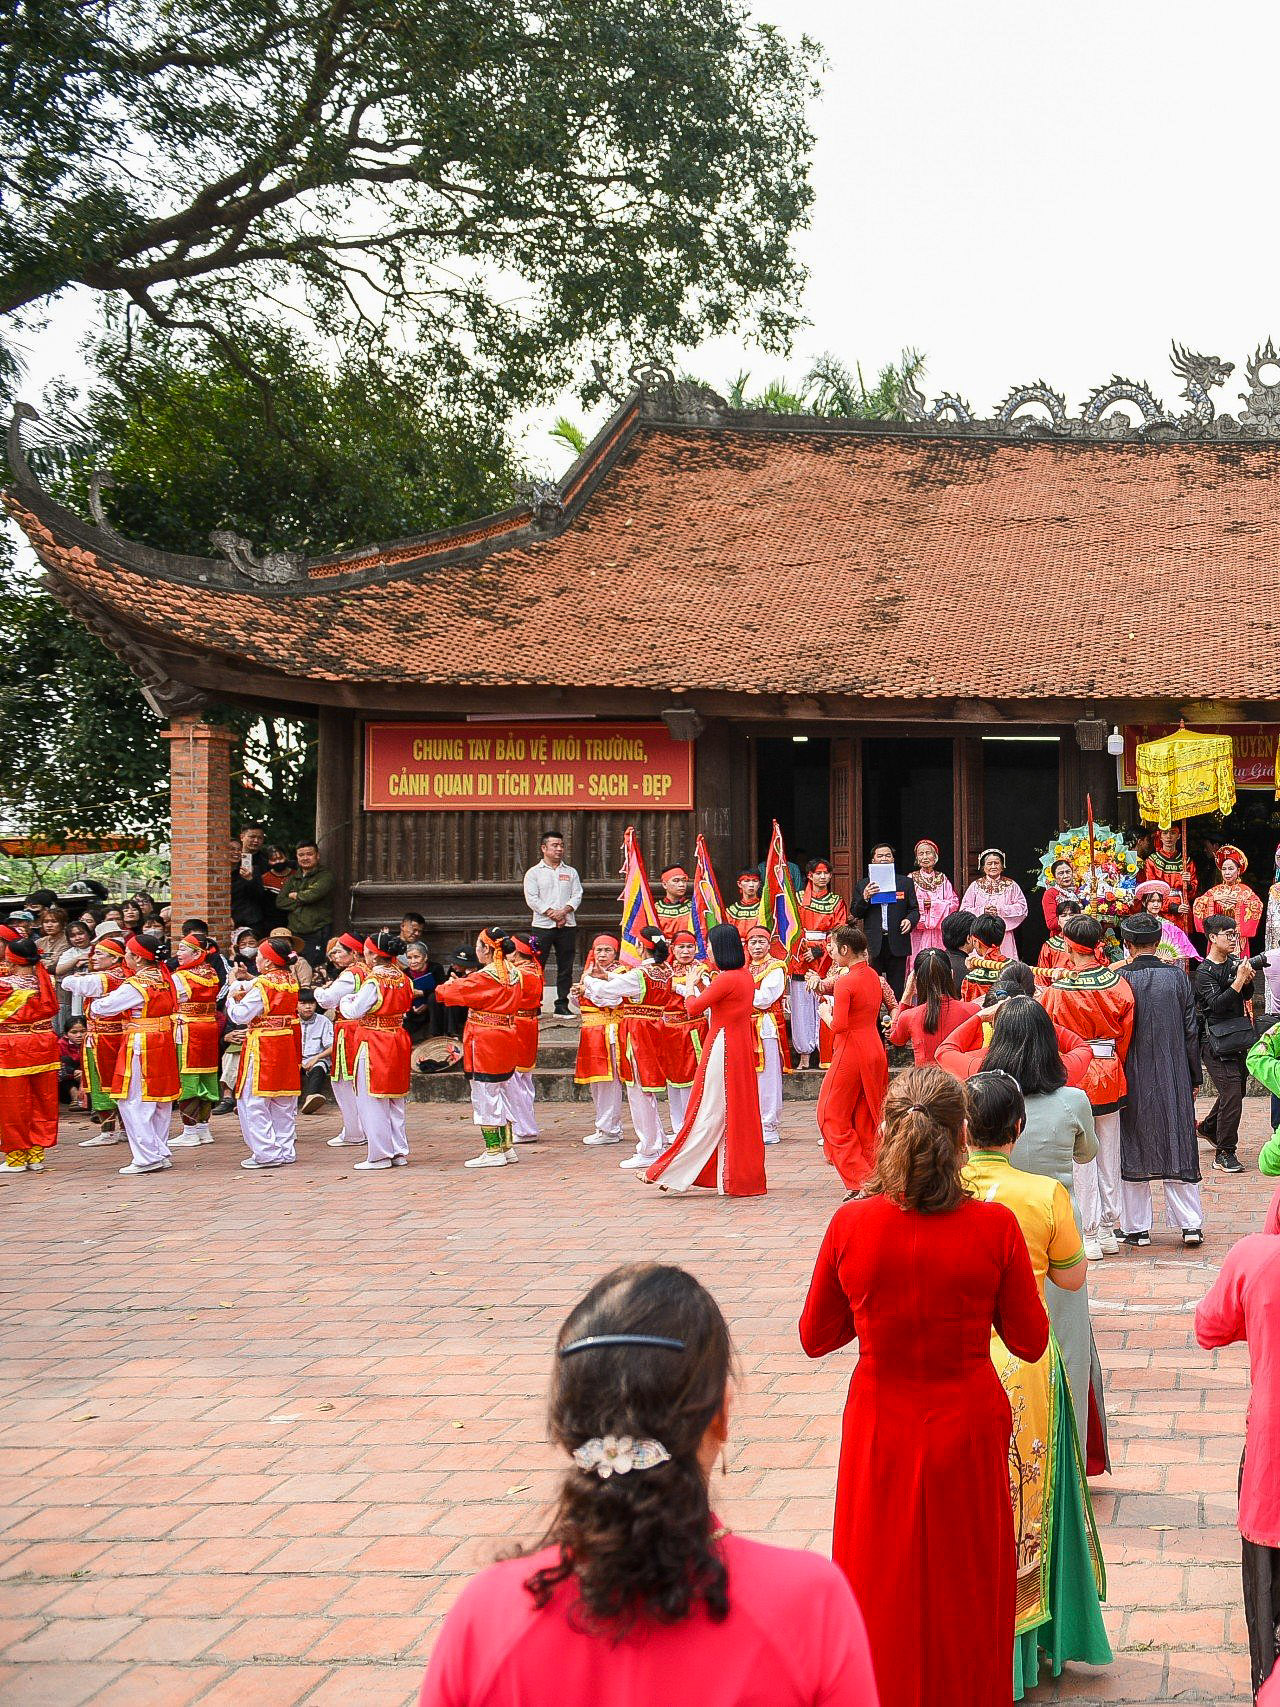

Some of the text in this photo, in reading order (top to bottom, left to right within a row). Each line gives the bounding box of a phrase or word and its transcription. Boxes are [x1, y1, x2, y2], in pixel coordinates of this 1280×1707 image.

[413, 732, 648, 765] CHUNG TAY BẢO VỆ MÔI TRƯỜNG,
[389, 766, 430, 796] CẢNH
[433, 774, 474, 798] QUAN
[477, 774, 493, 796] DI
[496, 769, 530, 796] TÍCH
[533, 774, 574, 796] XANH
[588, 774, 628, 800] SẠCH
[642, 774, 672, 800] ĐẸP
